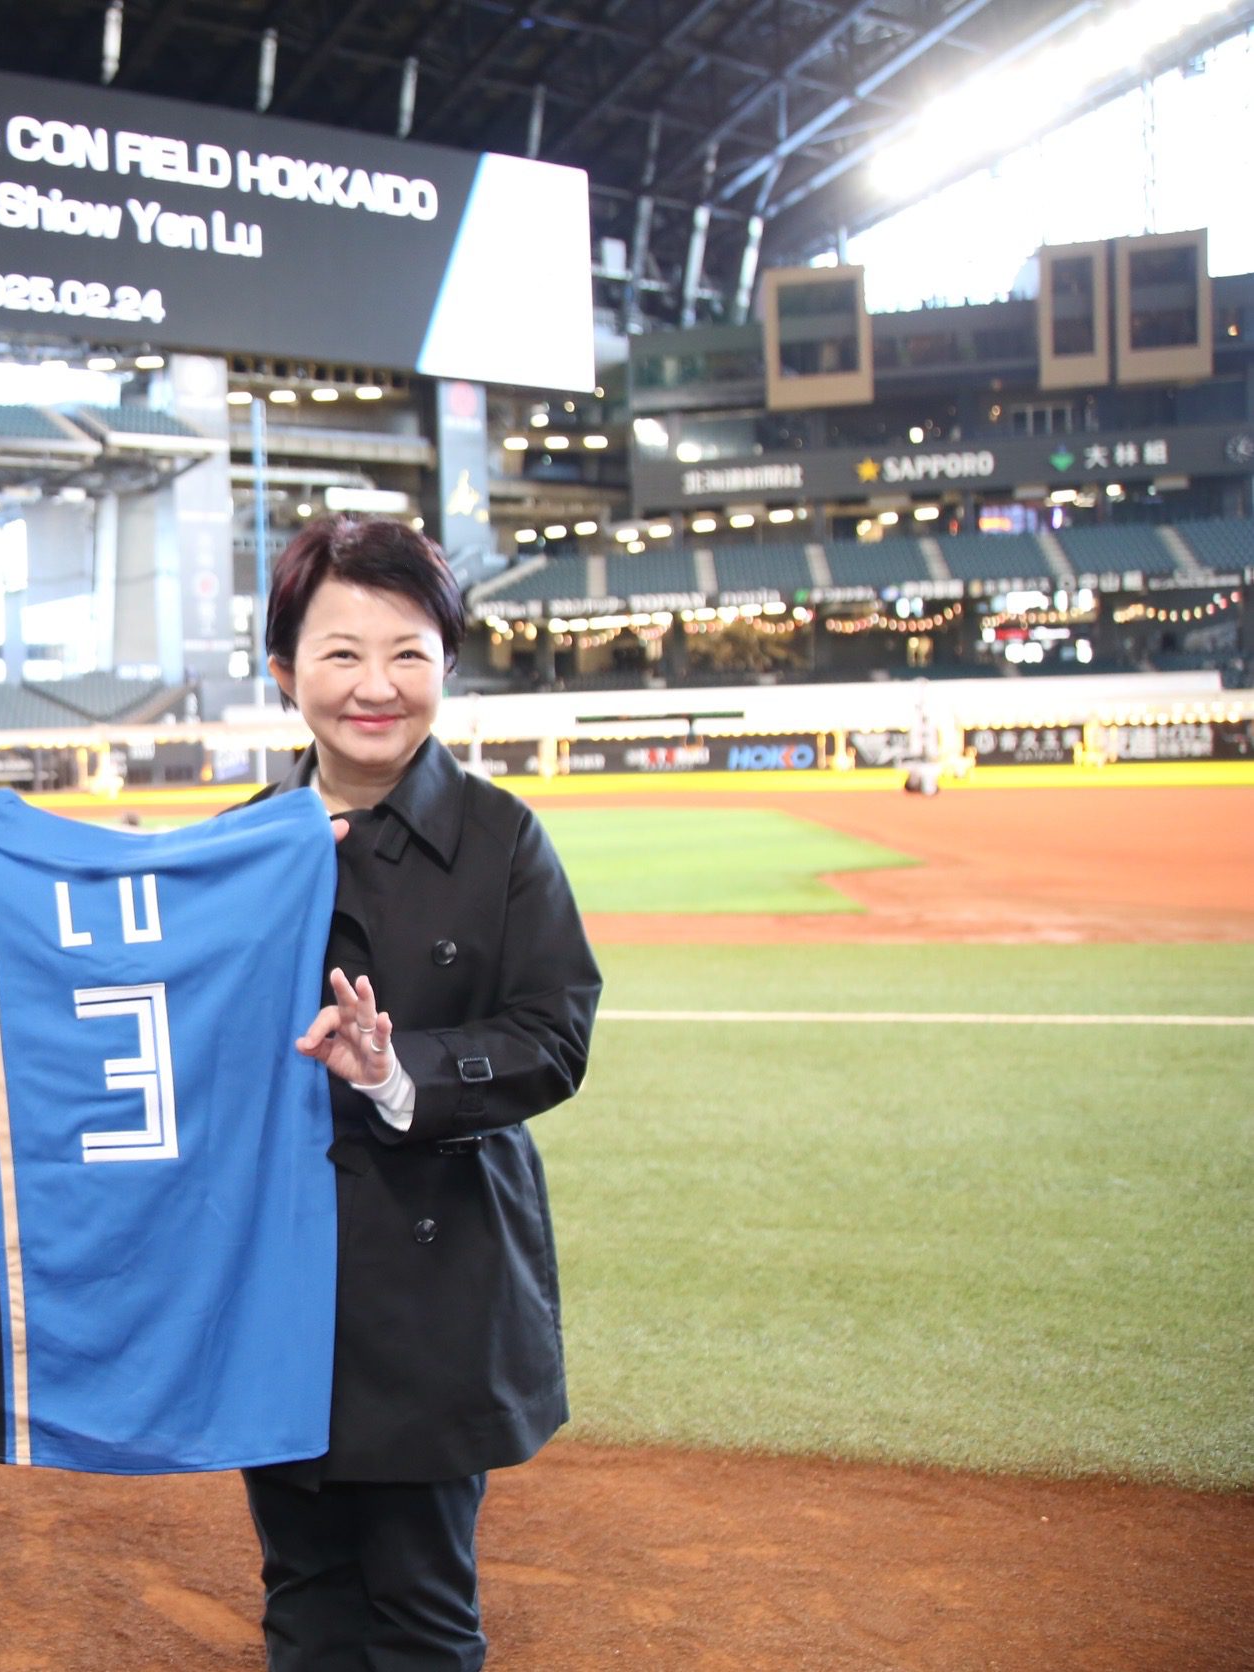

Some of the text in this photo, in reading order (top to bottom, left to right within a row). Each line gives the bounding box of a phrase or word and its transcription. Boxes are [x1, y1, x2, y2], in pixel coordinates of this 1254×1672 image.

[7, 116, 108, 171] CON
[116, 132, 232, 188] FIELD
[237, 151, 438, 220] HOKKAIDO
[127, 199, 207, 250] Yen
[212, 211, 262, 257] Lu
[882, 450, 995, 483] SAPPORO
[55, 873, 162, 948] LU
[73, 982, 179, 1164] 3
